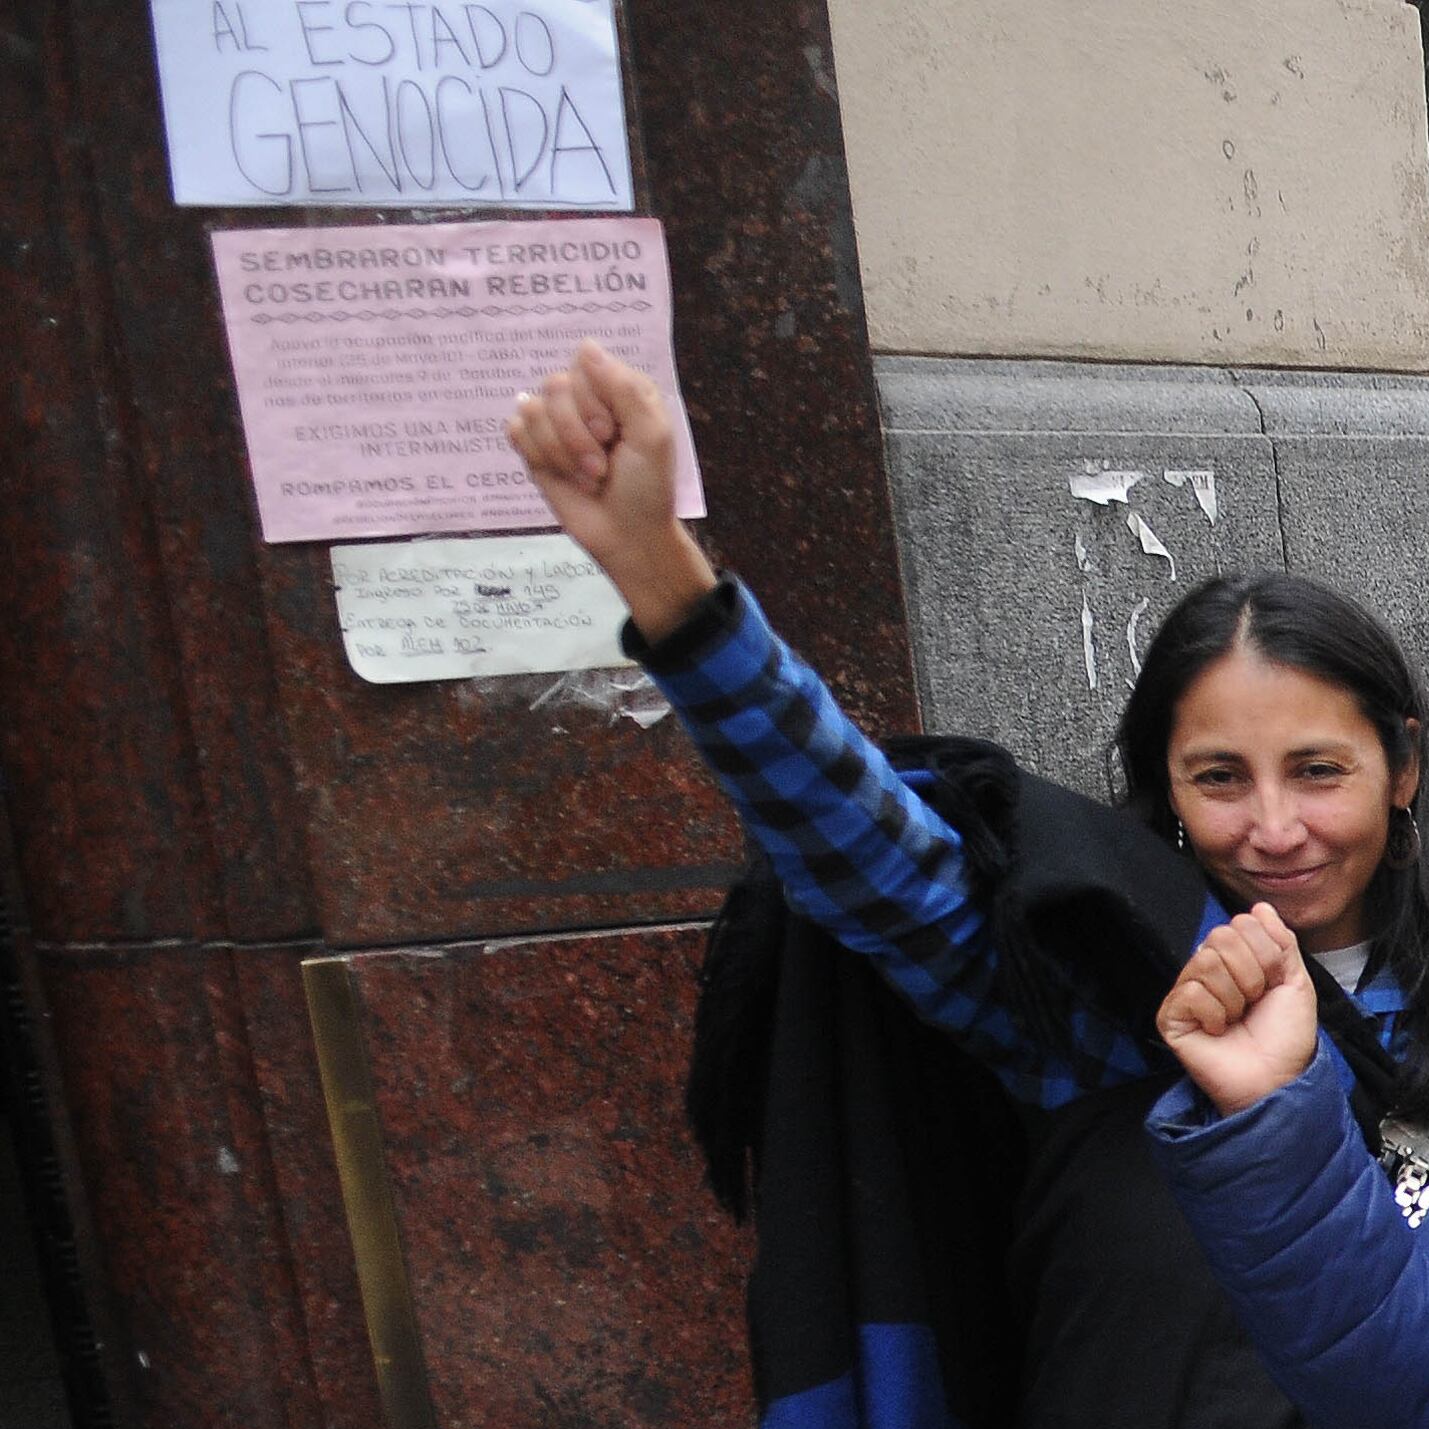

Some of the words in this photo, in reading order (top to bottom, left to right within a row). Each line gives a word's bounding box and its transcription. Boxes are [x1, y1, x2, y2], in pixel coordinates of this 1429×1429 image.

[211, 0, 268, 53] AL
[297, 0, 553, 76] ESTADO
[229, 70, 618, 199] GENOCIDA
[240, 246, 446, 273] SEMBRARON
[462, 239, 642, 268] TERRICIDIO
[244, 277, 471, 305] COSECHARAN
[487, 266, 648, 296] REBELIÓN
[294, 420, 397, 442] EXIGIMOS
[405, 417, 449, 438] UNA
[360, 435, 508, 458] INTERMINISTE
[280, 475, 414, 498] ROMPAMOS
[426, 475, 455, 490] EL
